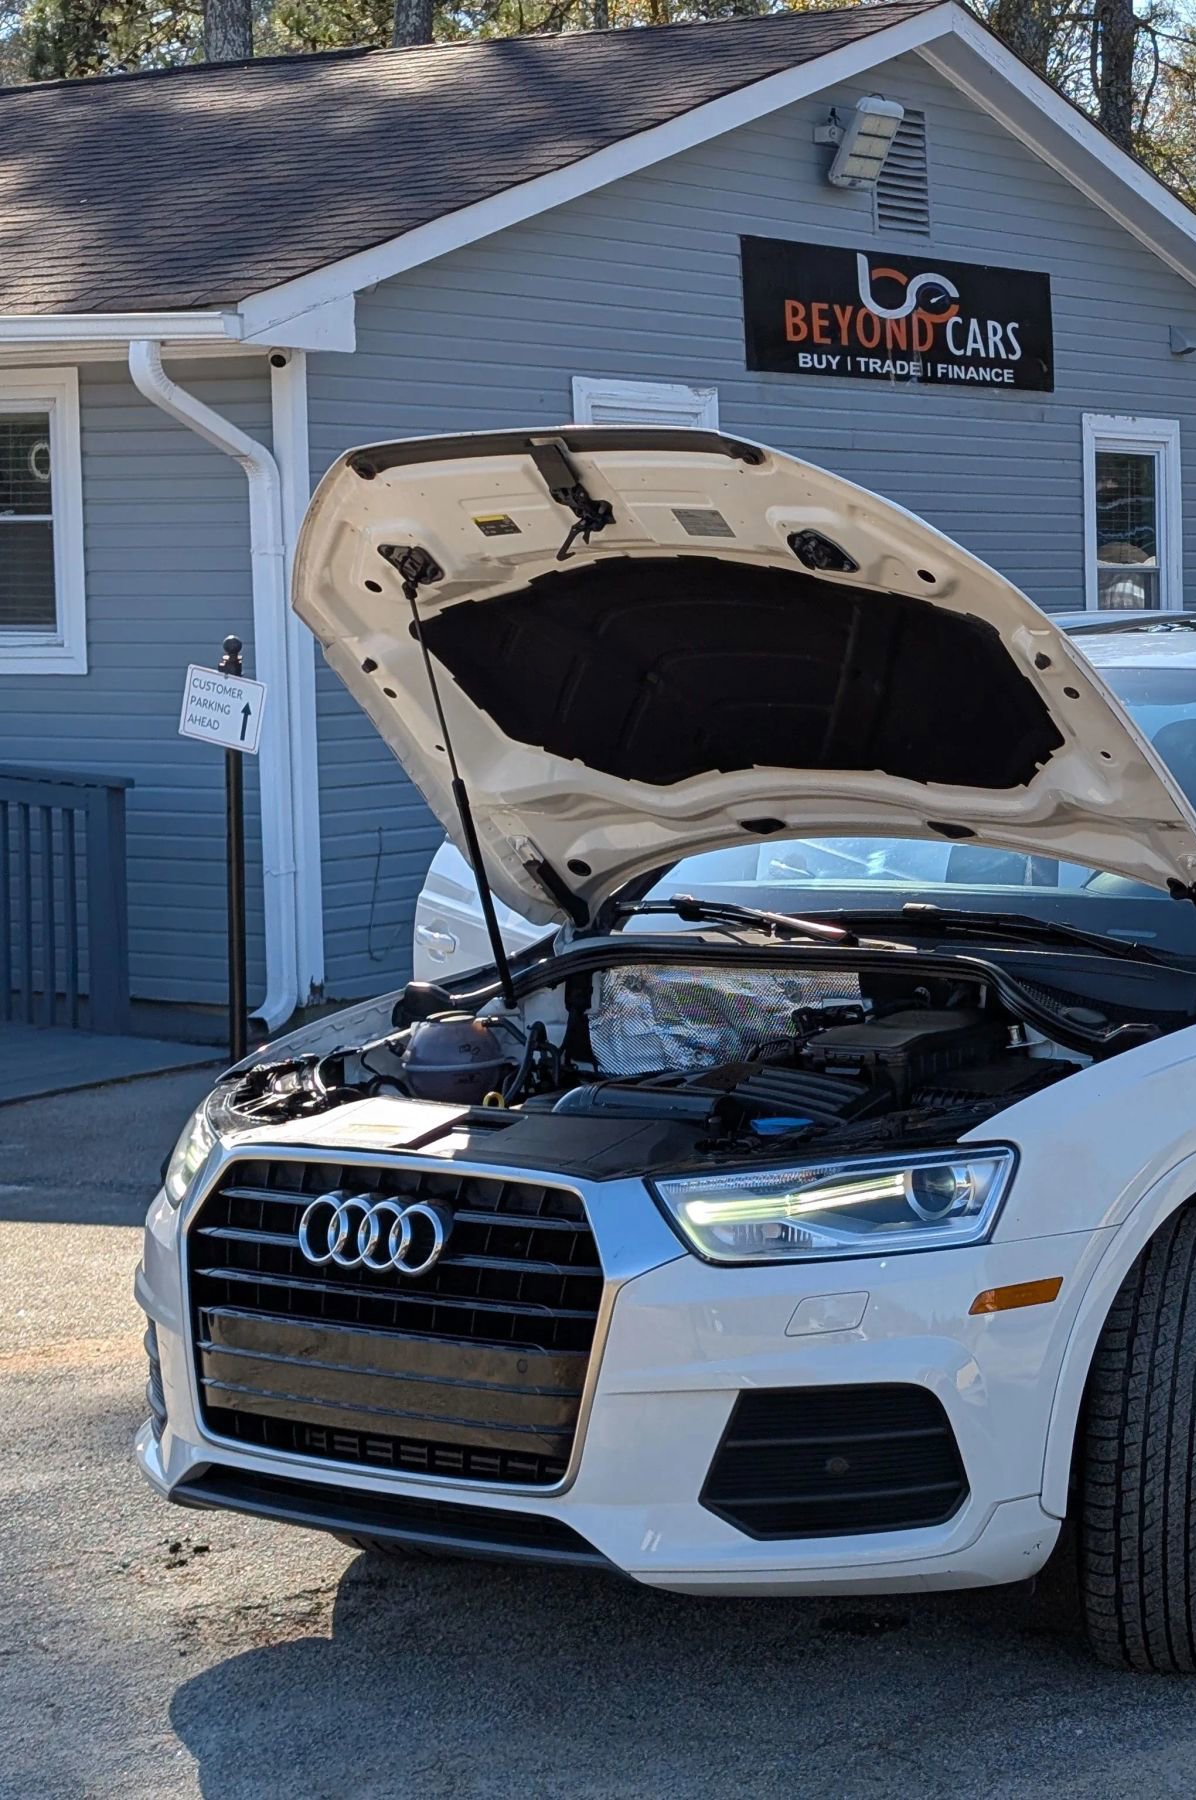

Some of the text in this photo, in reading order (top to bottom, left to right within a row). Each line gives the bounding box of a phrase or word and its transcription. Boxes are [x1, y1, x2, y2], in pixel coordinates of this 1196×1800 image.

[784, 299, 1022, 361] BEYOND CARS
[798, 352, 1014, 383] BUY TRADE FINANCE
[192, 678, 243, 700] CUSTOMER
[190, 696, 231, 715] PARKING
[187, 713, 220, 730] AHEAD
